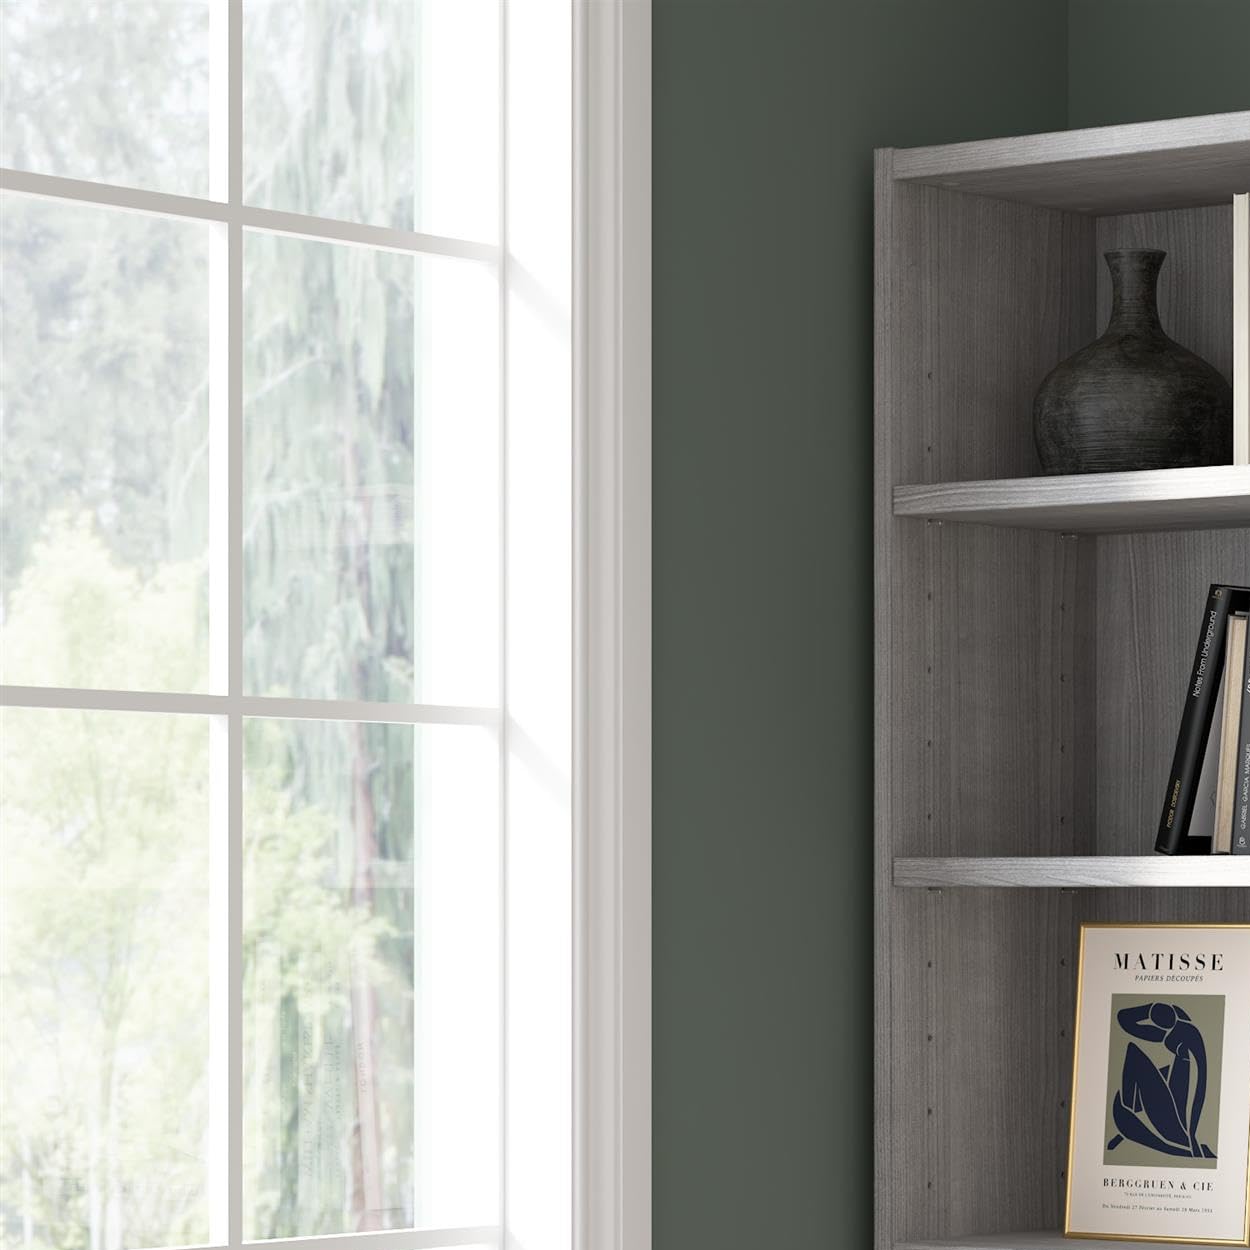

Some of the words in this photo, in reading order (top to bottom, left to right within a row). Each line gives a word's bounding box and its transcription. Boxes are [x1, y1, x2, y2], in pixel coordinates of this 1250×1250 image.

[1201, 610, 1217, 657] Underground
[1197, 657, 1208, 675] From
[1192, 675, 1203, 698] Notes
[1242, 776, 1250, 802] GARCIA
[1240, 804, 1248, 830] GABRIEL
[1113, 953, 1225, 972] MATISSE
[1134, 974, 1164, 983] PAPIERS
[1103, 1178, 1175, 1190] BERGGRUEN
[1193, 1181, 1214, 1191] CIE
